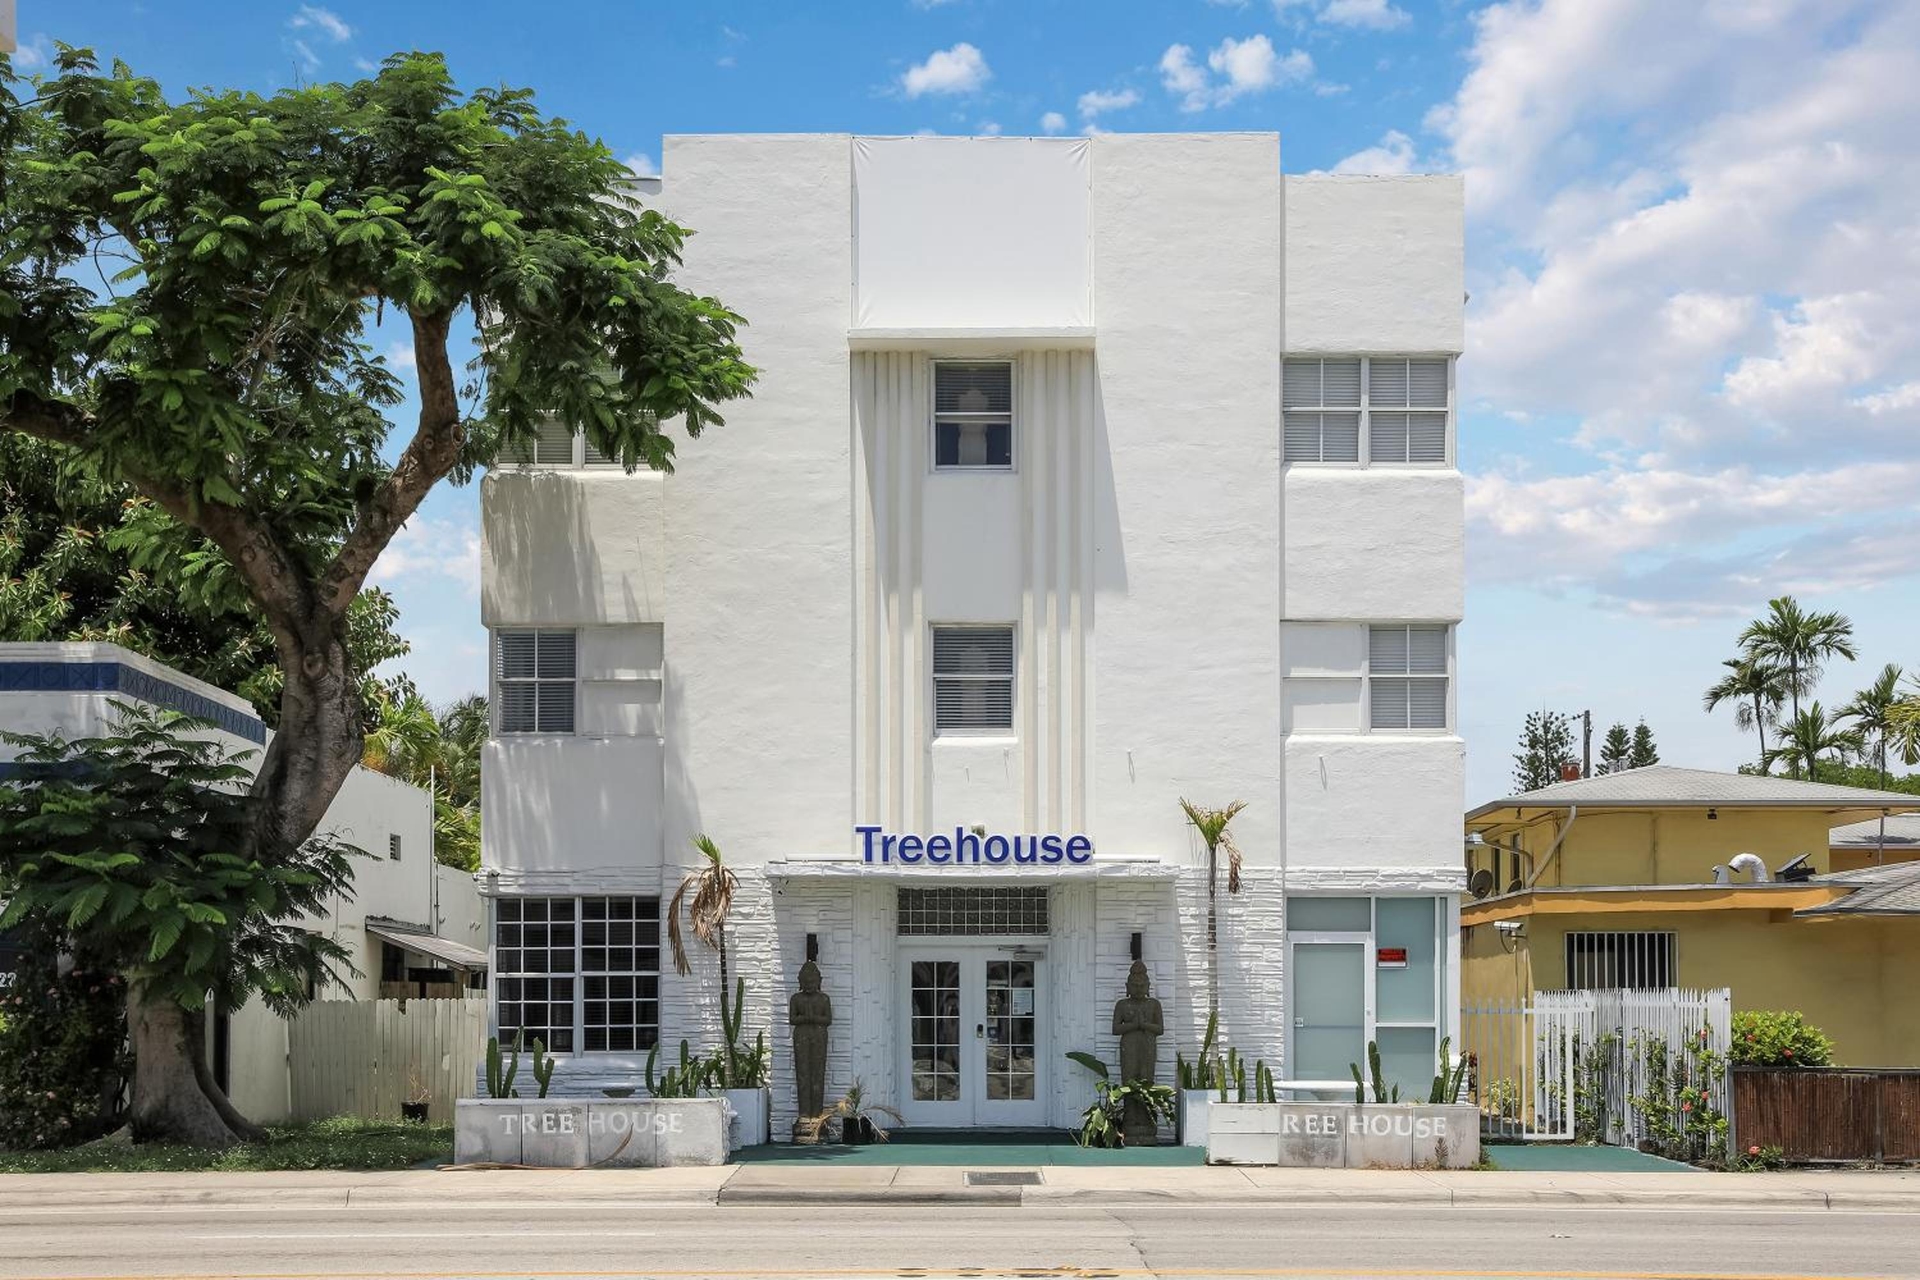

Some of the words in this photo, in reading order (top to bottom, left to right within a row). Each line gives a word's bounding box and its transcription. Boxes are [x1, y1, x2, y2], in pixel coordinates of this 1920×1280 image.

[855, 826, 1092, 863] Treehouse
[499, 1113, 574, 1135] TREE
[588, 1112, 683, 1134] HOUSE
[1350, 1114, 1448, 1138] HOUSE
